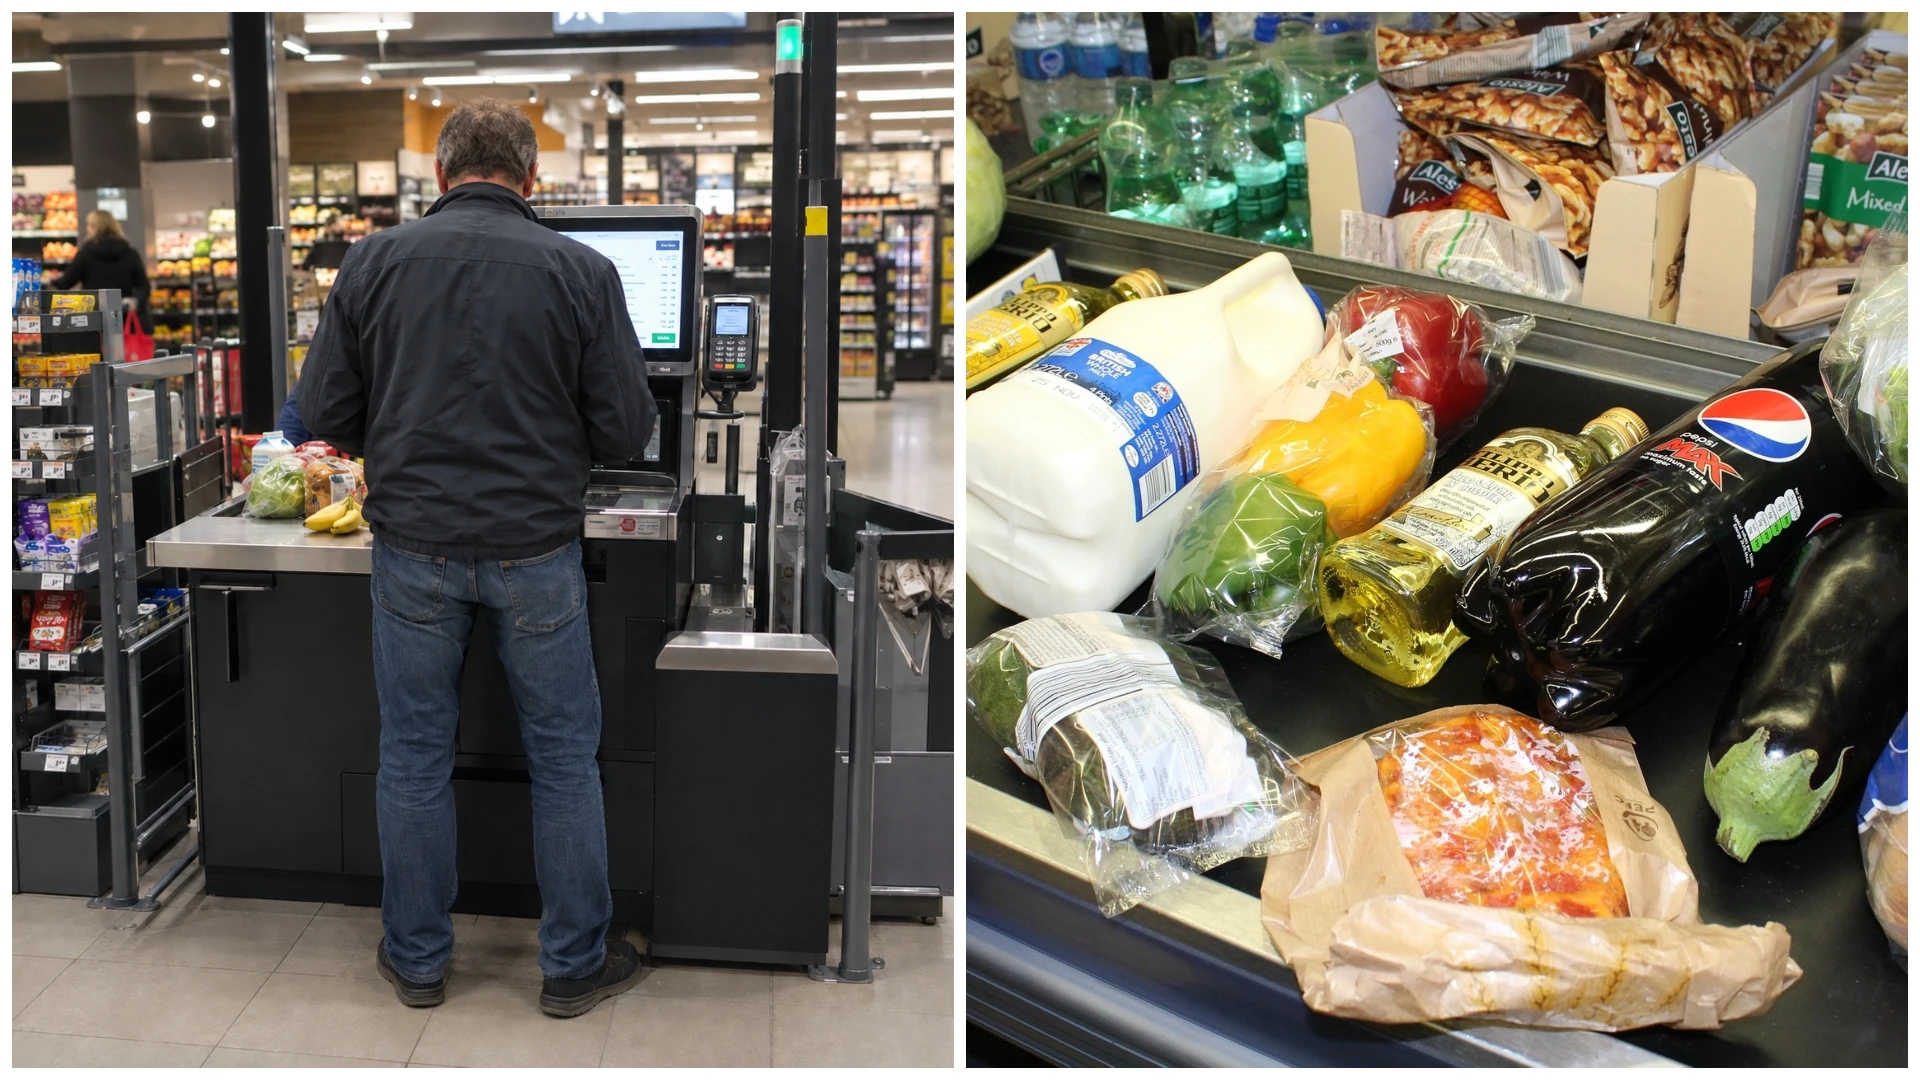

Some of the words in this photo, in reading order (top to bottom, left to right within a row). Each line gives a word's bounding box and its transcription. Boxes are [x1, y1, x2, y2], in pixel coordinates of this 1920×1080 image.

[1489, 77, 1554, 95] Alesto
[1846, 186, 1907, 212] Mixed
[1084, 359, 1123, 380] WHOLE
[1087, 353, 1133, 378] BRITISH
[1087, 367, 1106, 379] MILK
[1030, 376, 1048, 387] 25
[1054, 384, 1082, 401] NOV
[1089, 386, 1097, 395] 4
[1094, 388, 1114, 406] Pints
[1680, 431, 1719, 448] pepsi
[1644, 451, 1686, 469] maximum
[1685, 466, 1708, 486] taste
[1648, 456, 1671, 468] sugar
[1650, 437, 1744, 492] MAX
[1459, 483, 1502, 505] COLOUR
[1732, 514, 1743, 530] Typical
